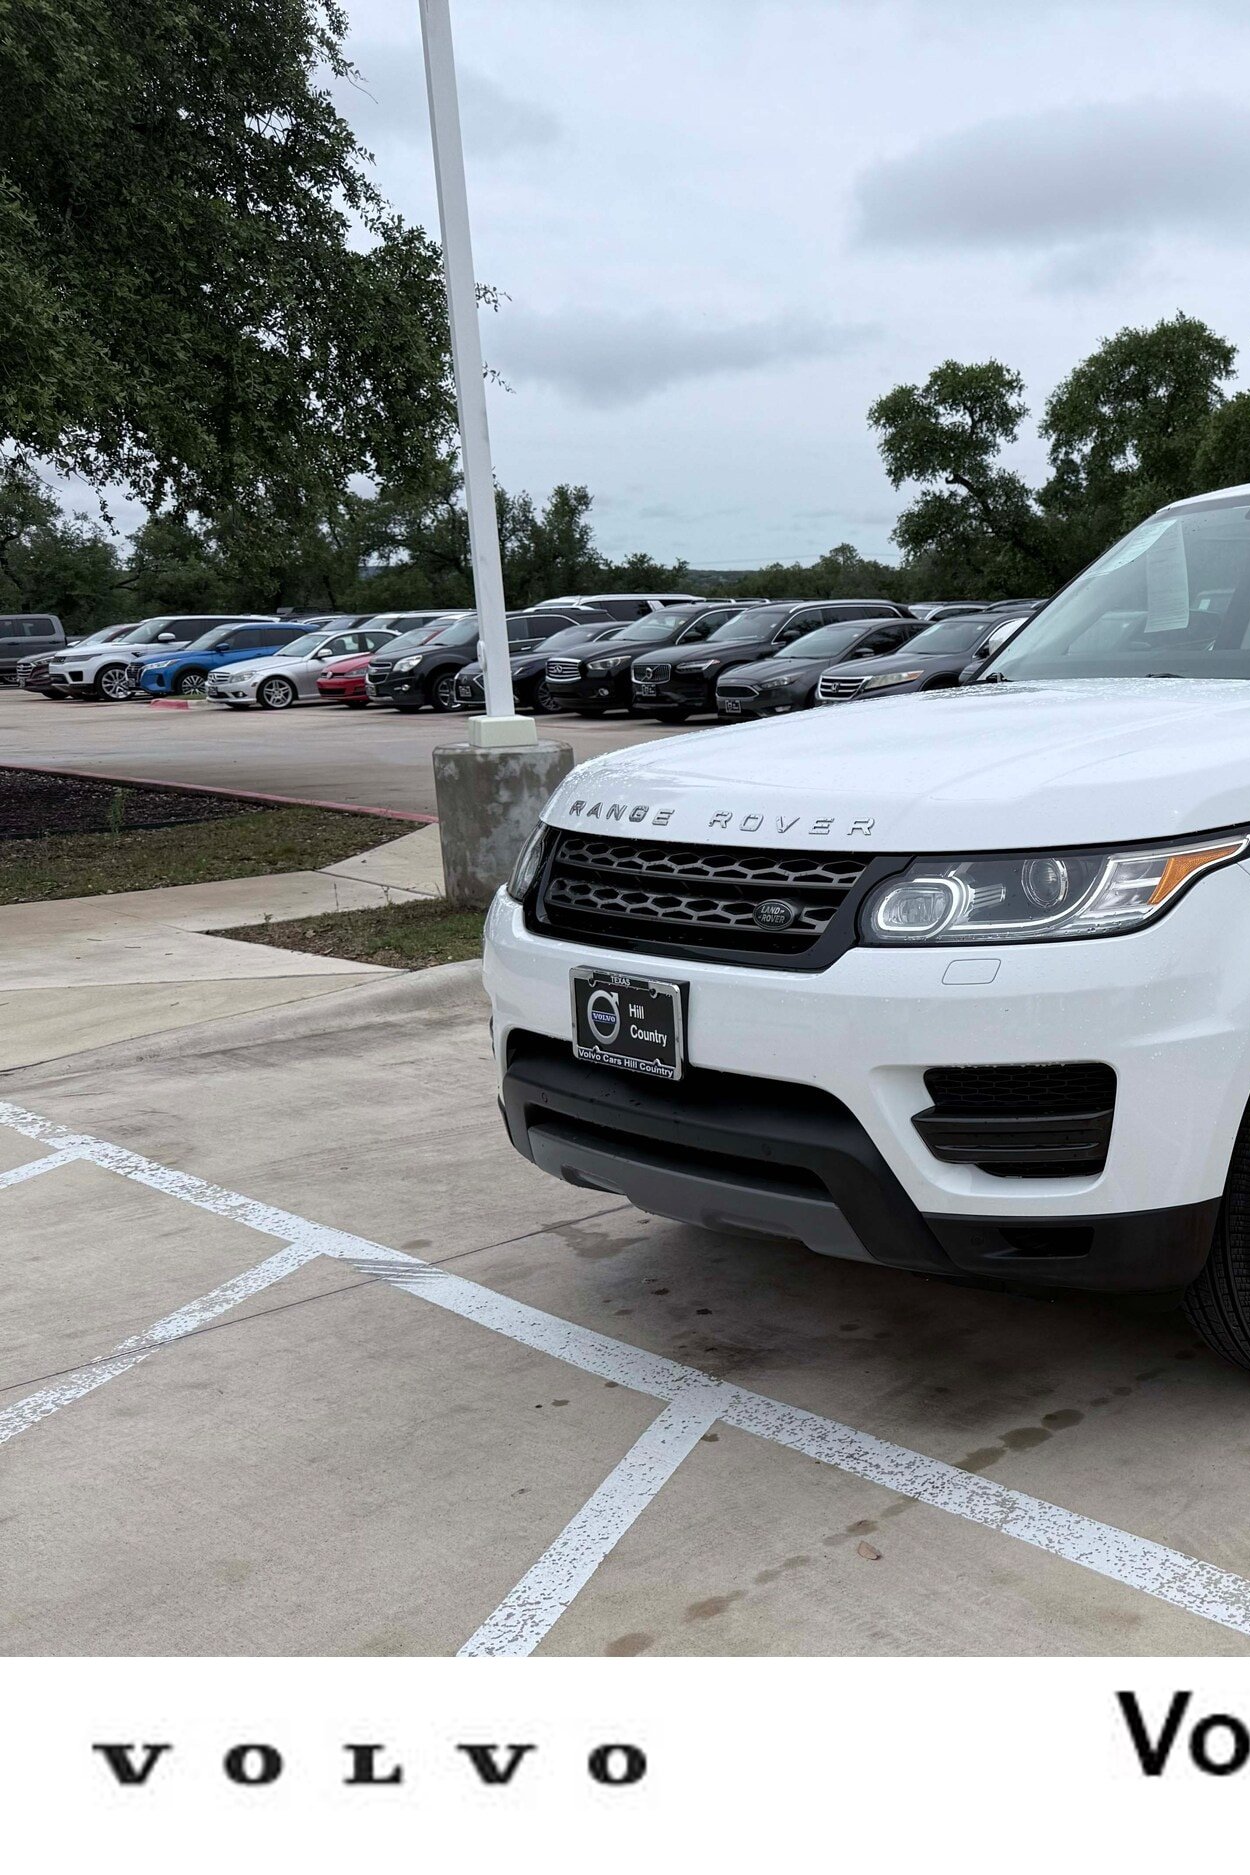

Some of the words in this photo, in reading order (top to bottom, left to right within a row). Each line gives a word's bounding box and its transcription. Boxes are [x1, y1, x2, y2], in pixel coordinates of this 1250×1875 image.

[569, 800, 674, 826] RANGE
[708, 809, 875, 836] ROVER
[761, 905, 780, 915] LAND
[761, 914, 785, 923] ROVER
[610, 977, 630, 986] TEXAS
[592, 1012, 616, 1023] VOLVO
[629, 1004, 644, 1019] Hill
[630, 1024, 668, 1047] Country
[578, 1048, 601, 1061] Volvo
[603, 1054, 622, 1066] Cars
[624, 1058, 638, 1069] Hill
[640, 1062, 674, 1078] Country
